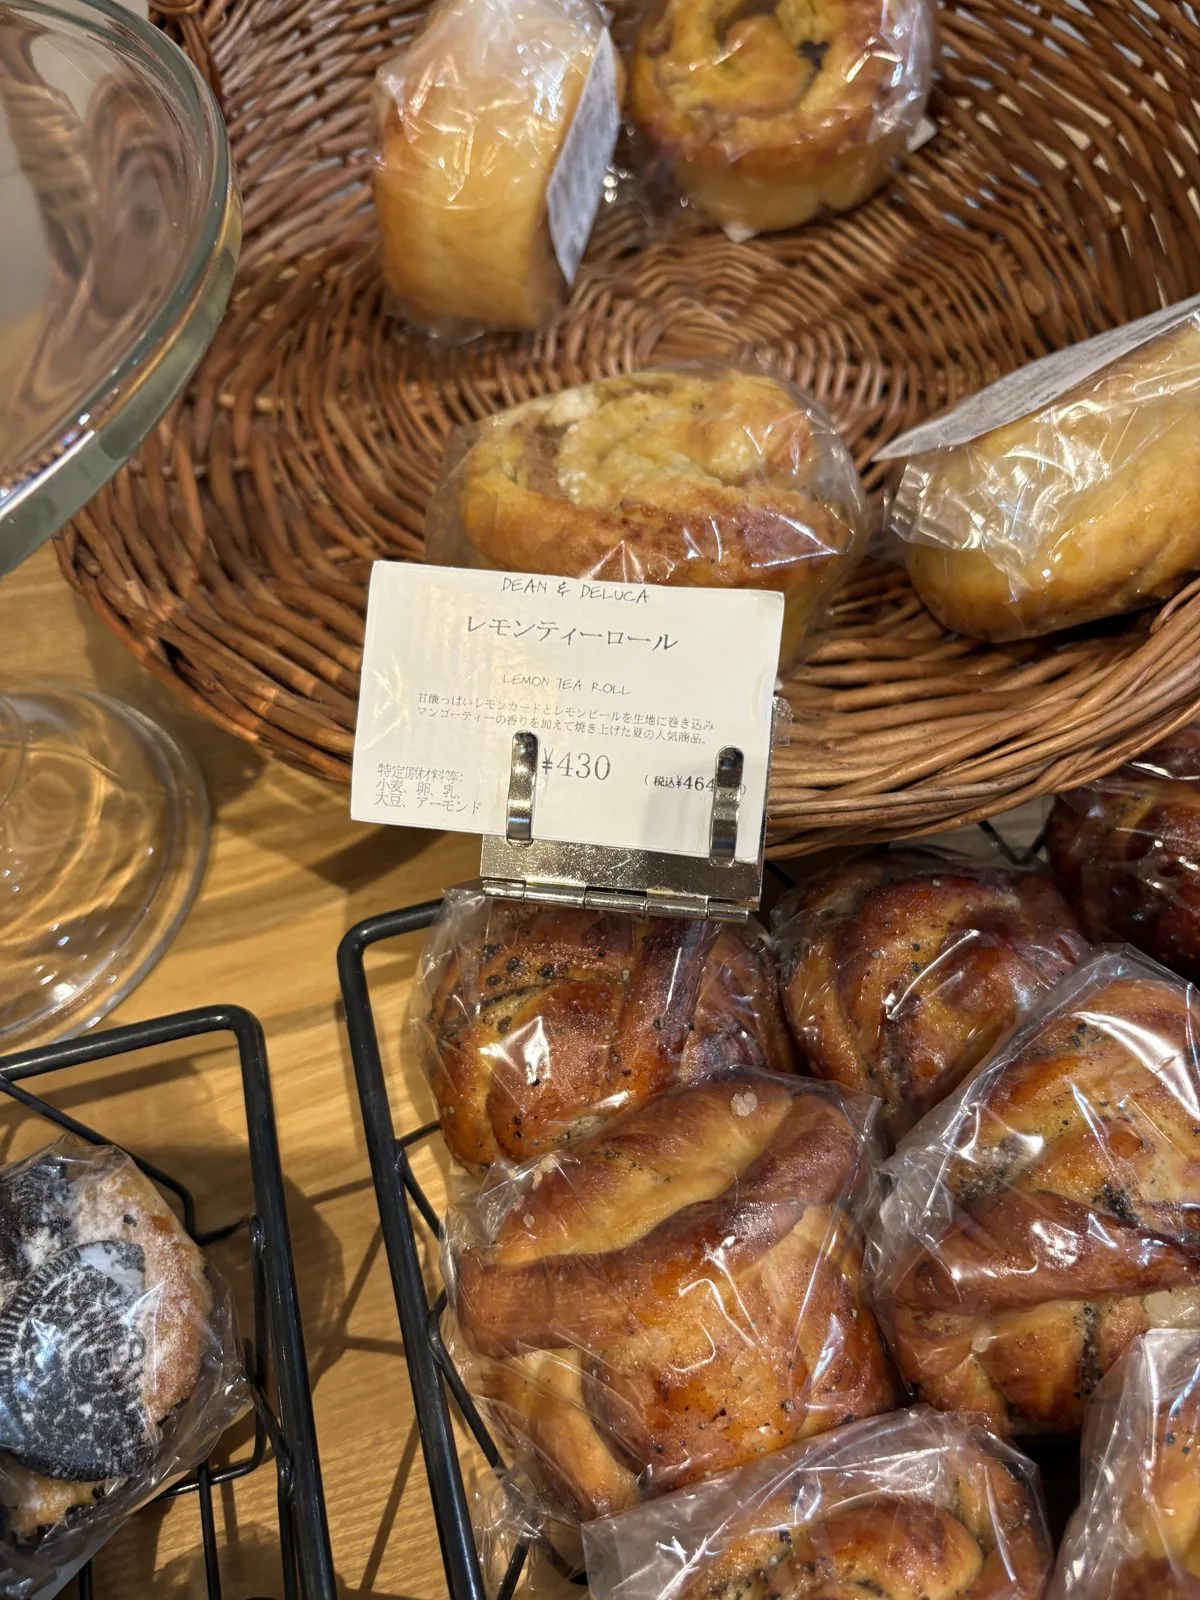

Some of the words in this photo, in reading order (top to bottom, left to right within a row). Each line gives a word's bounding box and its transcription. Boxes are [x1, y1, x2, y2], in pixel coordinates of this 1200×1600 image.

[501, 577, 547, 593] DEAN
[557, 581, 570, 596] &
[580, 584, 650, 604] DELUCA
[467, 615, 678, 651] レモンティーロール
[503, 674, 549, 690] LEMON
[557, 677, 582, 690] TEA
[591, 681, 631, 695] ROLL
[542, 748, 611, 781] ¥430
